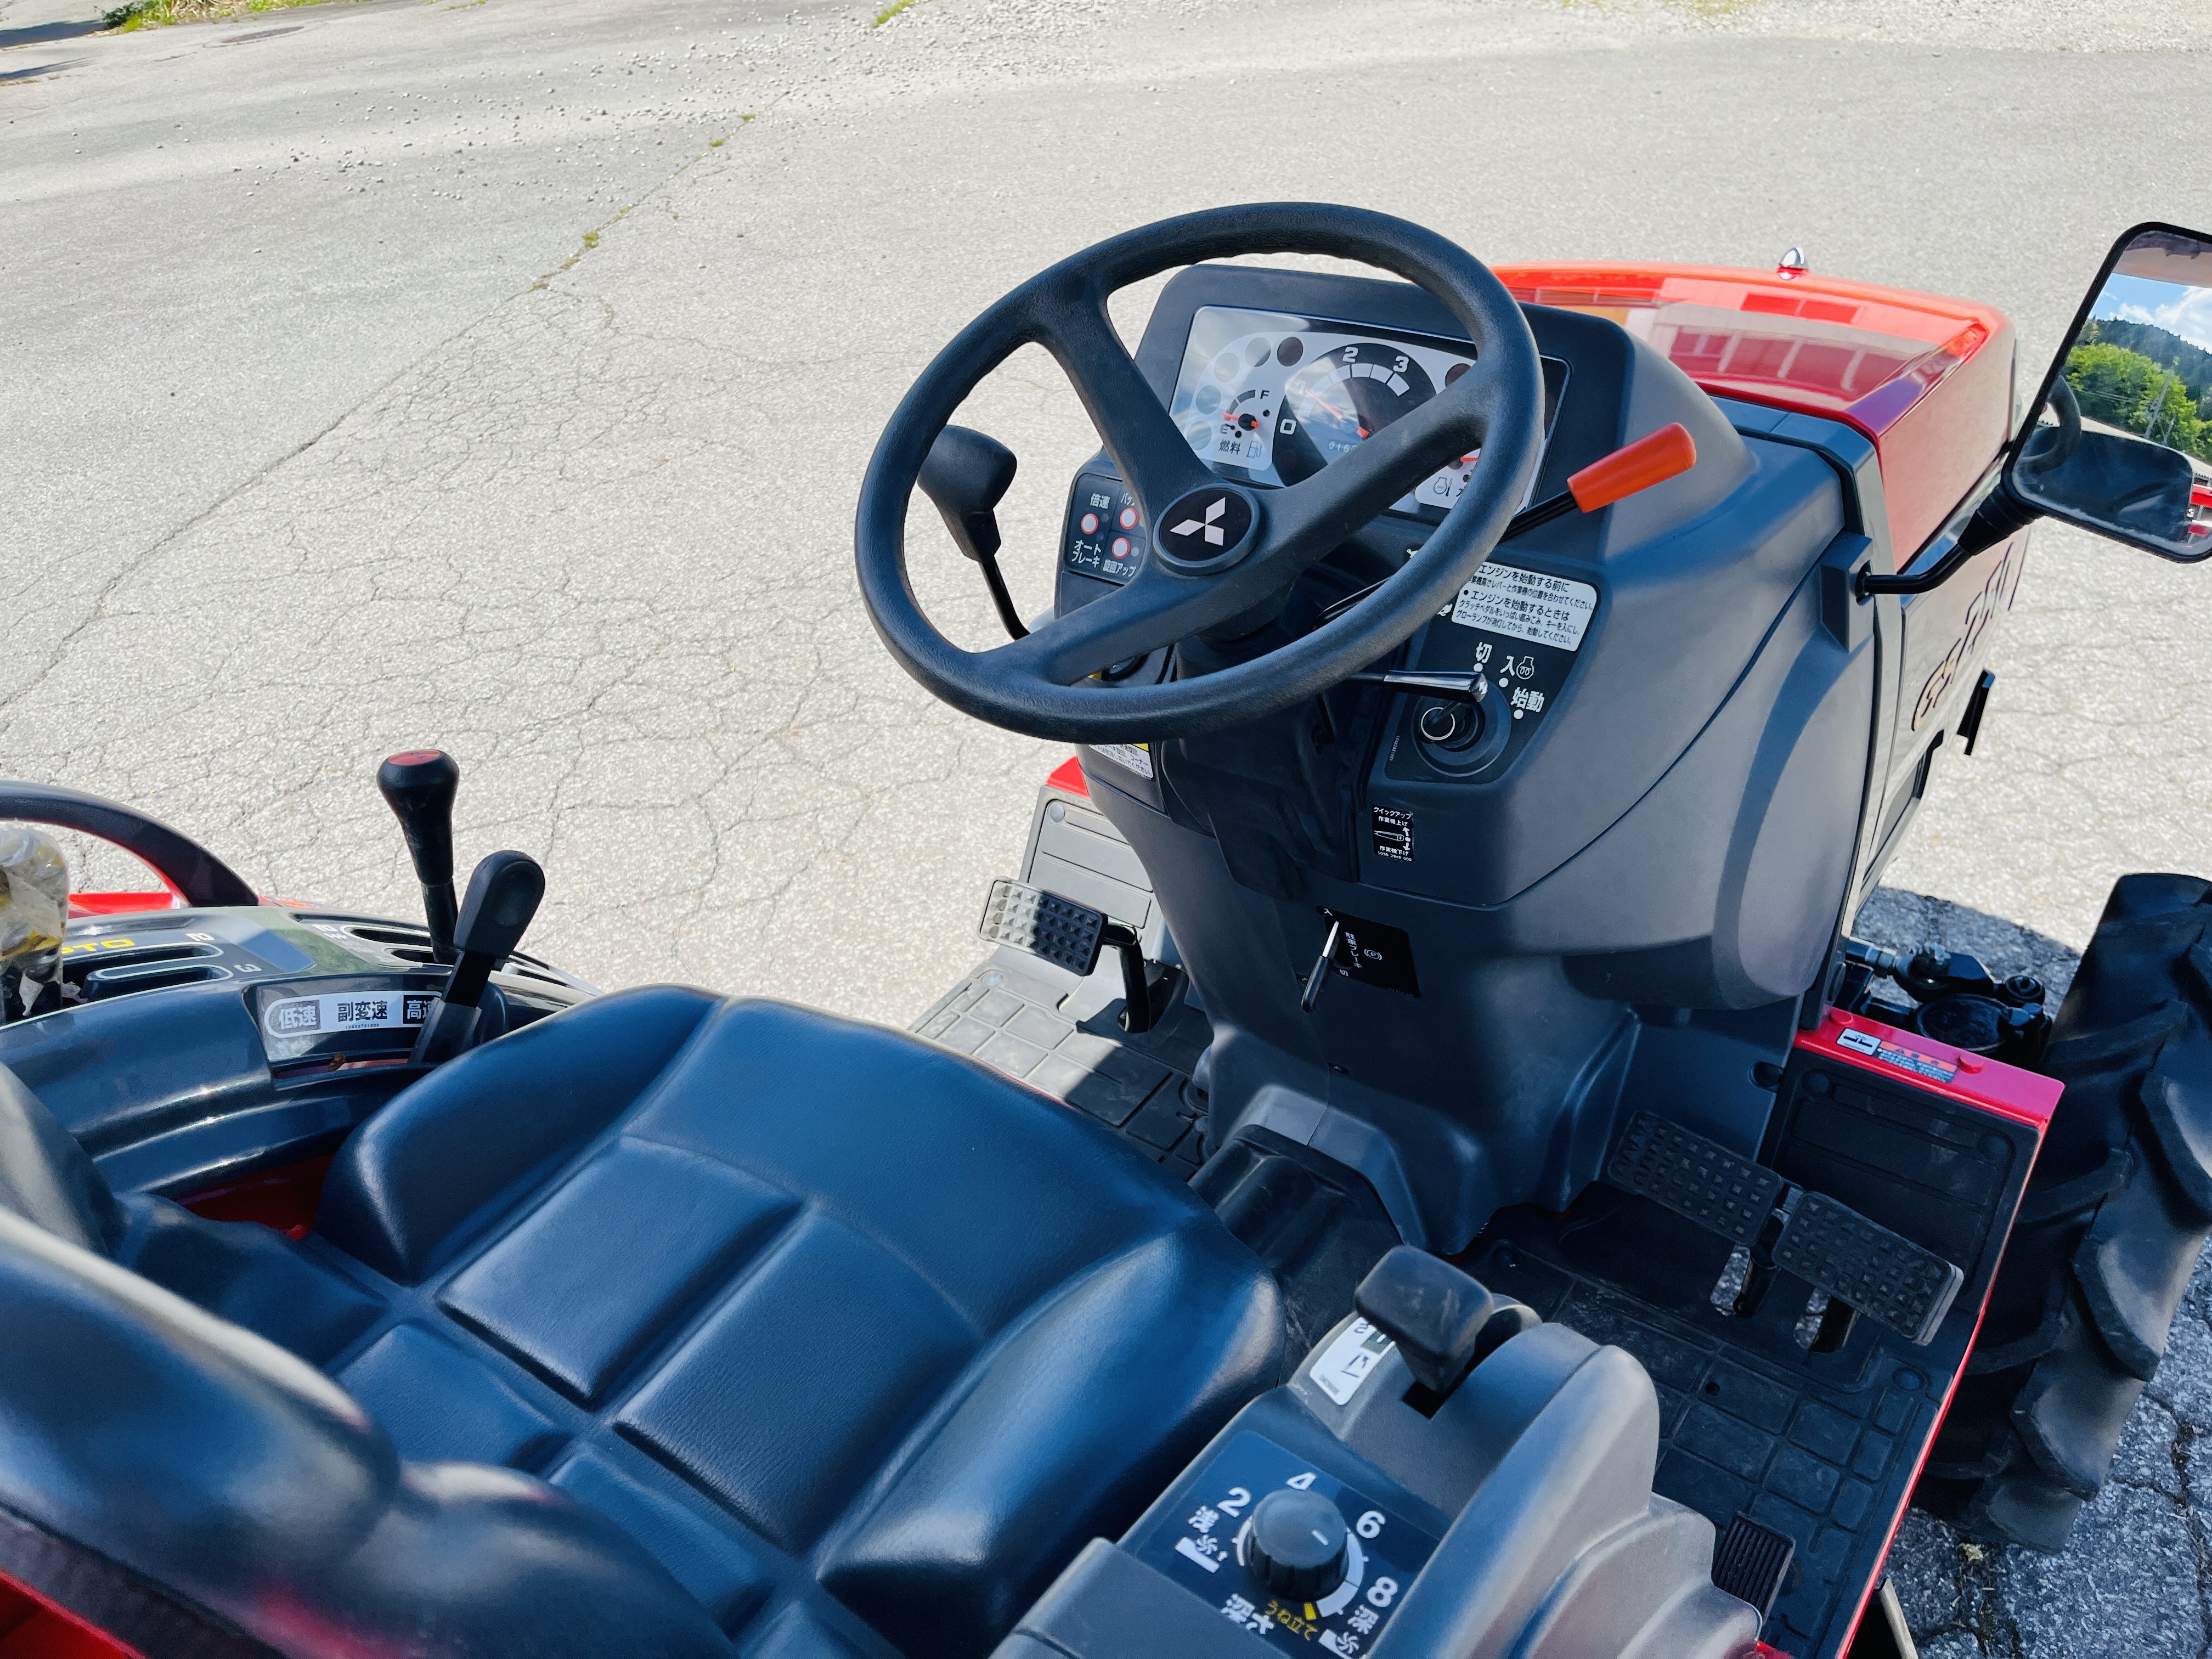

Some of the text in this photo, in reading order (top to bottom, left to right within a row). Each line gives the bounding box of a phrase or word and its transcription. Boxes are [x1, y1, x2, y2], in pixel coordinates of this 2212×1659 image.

[1342, 347, 1358, 363] 2
[1393, 356, 1409, 373] 3
[1260, 390, 1269, 399] F
[1296, 380, 1306, 394] 1
[1220, 424, 1228, 434] E
[1218, 439, 1240, 455] 燃料
[1090, 493, 1110, 509] 倍速
[1074, 540, 1101, 555] オート
[1103, 559, 1136, 577] 旋回アップ
[1476, 642, 1492, 664] 切
[1500, 655, 1515, 676] 入
[1510, 687, 1544, 713] 始動
[1374, 806, 1412, 819] クイックアップ
[279, 1005, 317, 1030] 低速
[337, 1000, 387, 1023] 副変速
[1286, 1472, 1316, 1491] 4
[1217, 1487, 1251, 1517] 2
[1357, 1511, 1385, 1538] 6
[1367, 1577, 1398, 1607] 8
